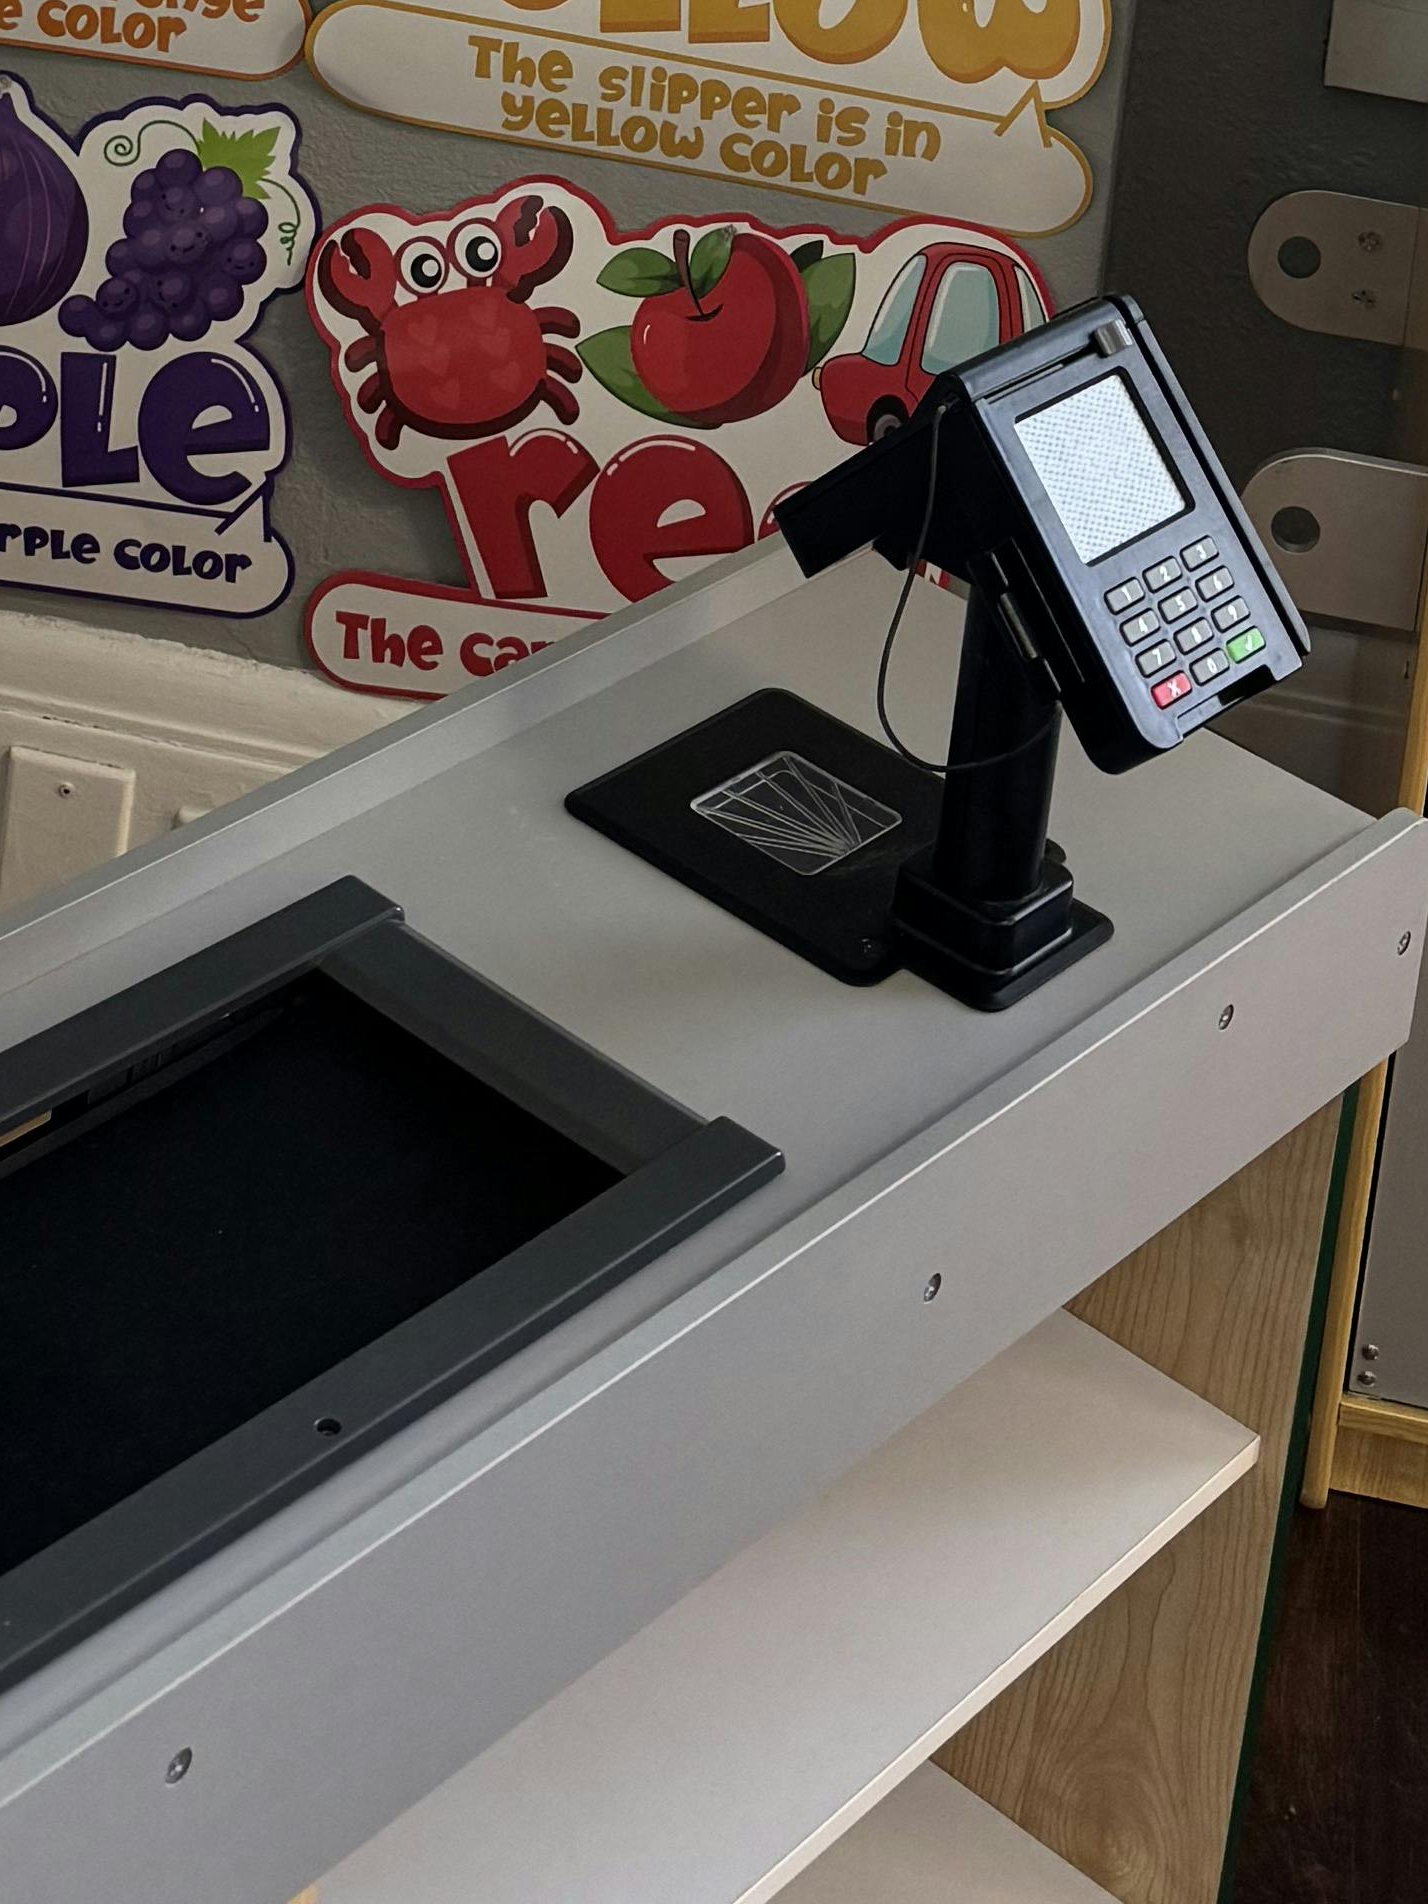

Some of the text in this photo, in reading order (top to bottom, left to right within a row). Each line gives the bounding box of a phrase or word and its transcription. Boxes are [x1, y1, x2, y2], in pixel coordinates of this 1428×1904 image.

[467, 35, 940, 163] The slipper is in
[447, 428, 809, 602] re
[336, 611, 443, 671] The
